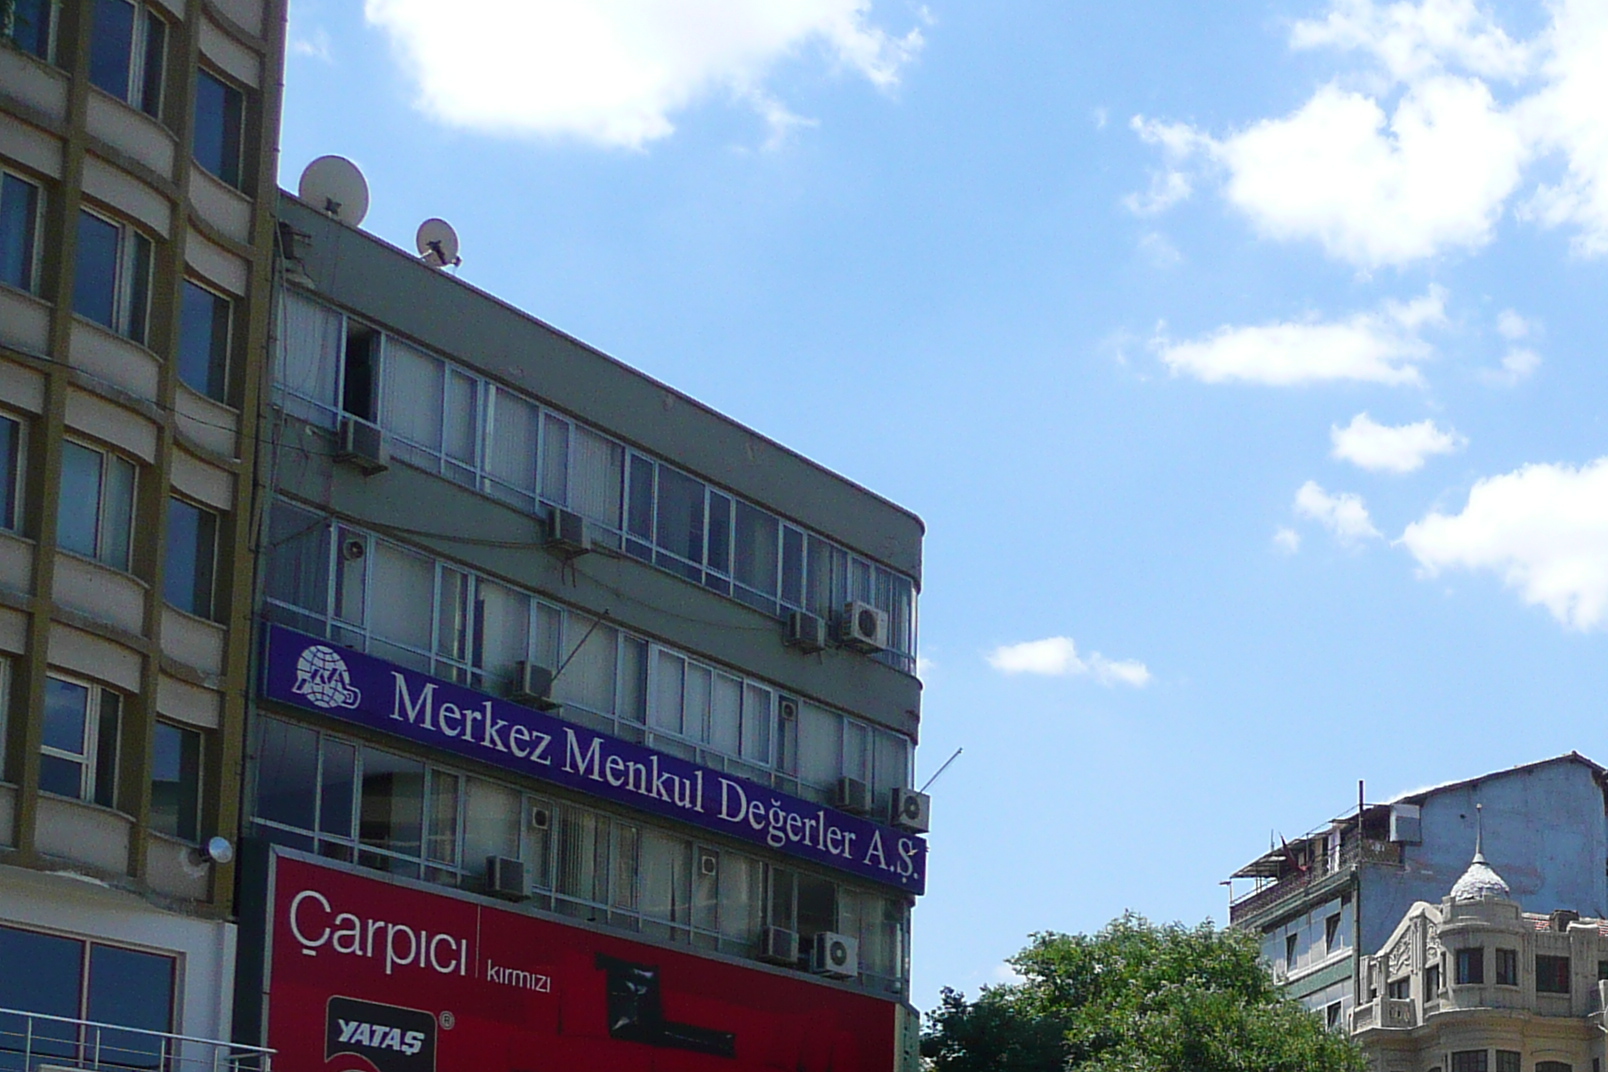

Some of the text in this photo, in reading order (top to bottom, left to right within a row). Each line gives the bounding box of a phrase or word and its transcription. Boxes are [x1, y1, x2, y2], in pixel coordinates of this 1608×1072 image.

[390, 670, 921, 884] Merkez Menkul Değerler A.Ş.
[288, 889, 551, 994] Çarpıcı kırmızı
[335, 1016, 425, 1056] YATAŞ
